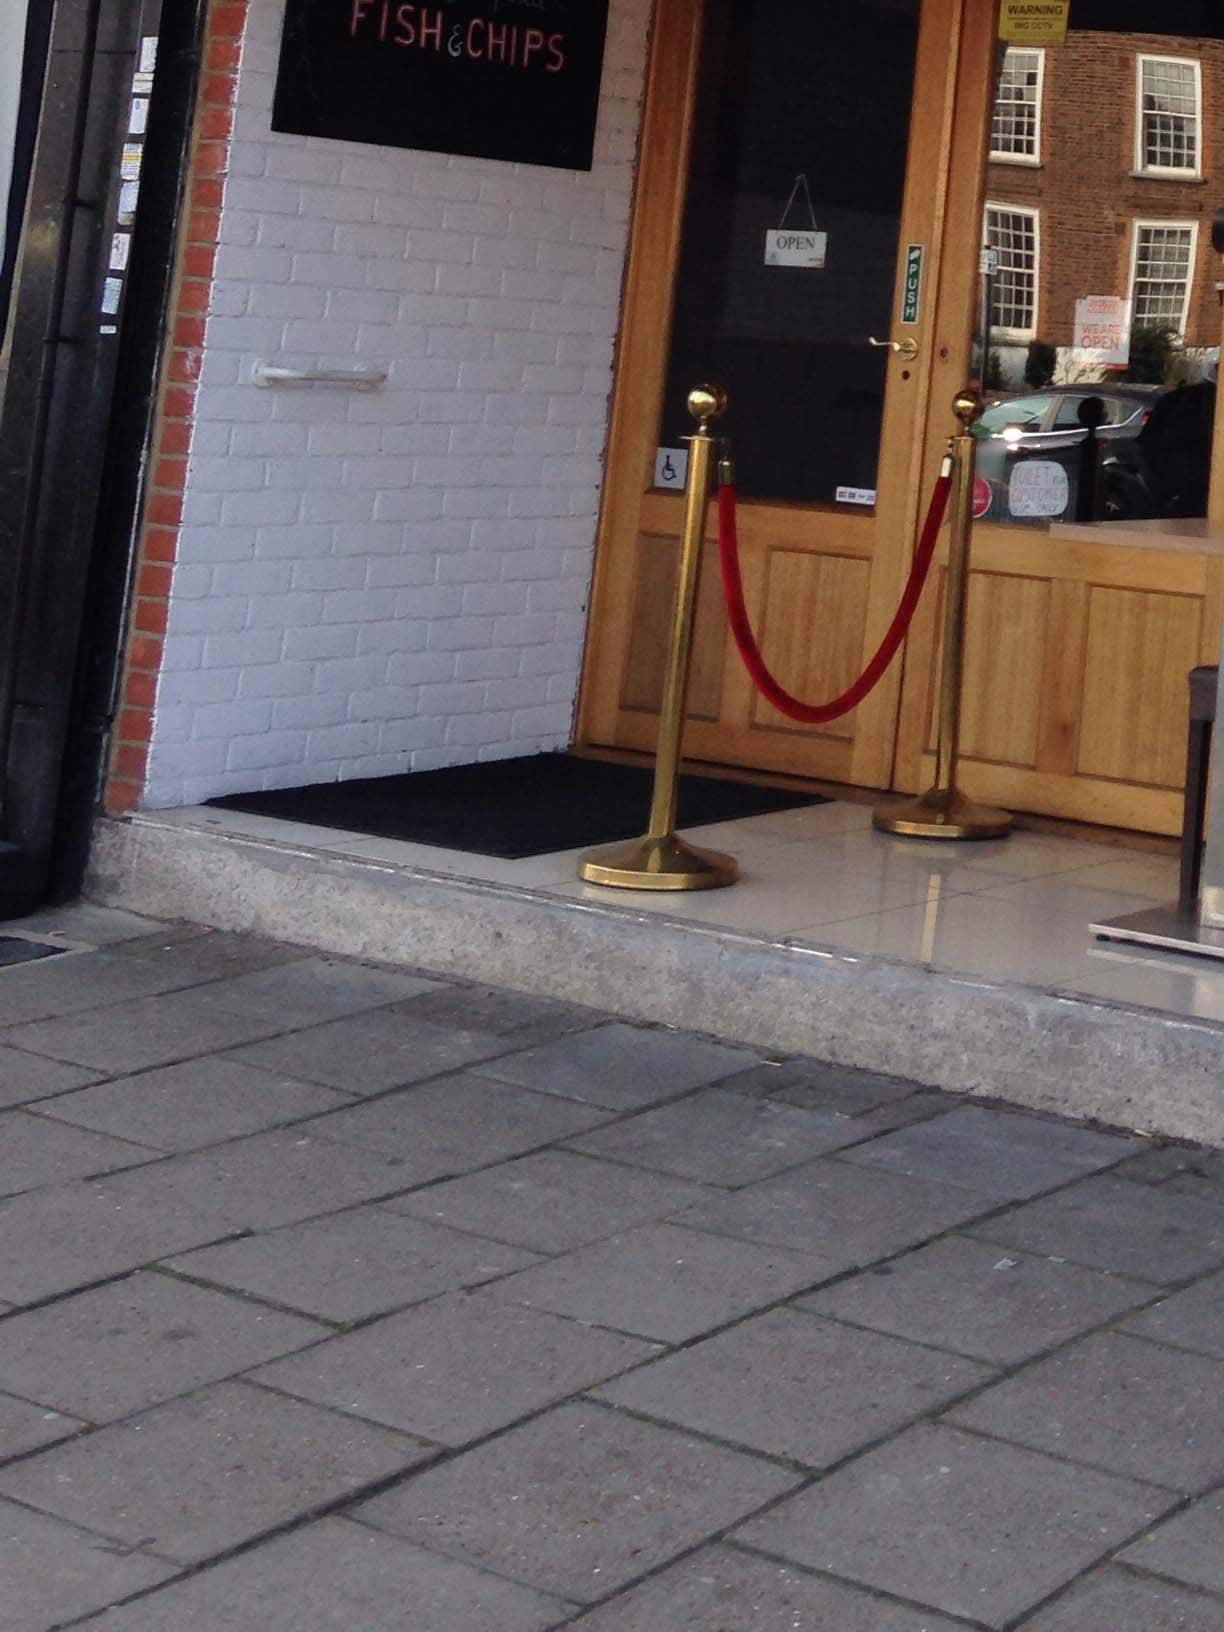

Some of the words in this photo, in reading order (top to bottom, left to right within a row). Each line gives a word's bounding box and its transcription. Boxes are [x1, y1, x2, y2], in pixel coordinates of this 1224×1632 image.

[1007, 4, 1063, 16] WARNING
[447, 24, 465, 58] &
[466, 18, 566, 73] CHIPS
[776, 235, 816, 250] OPEN
[905, 263, 919, 317] PUSH
